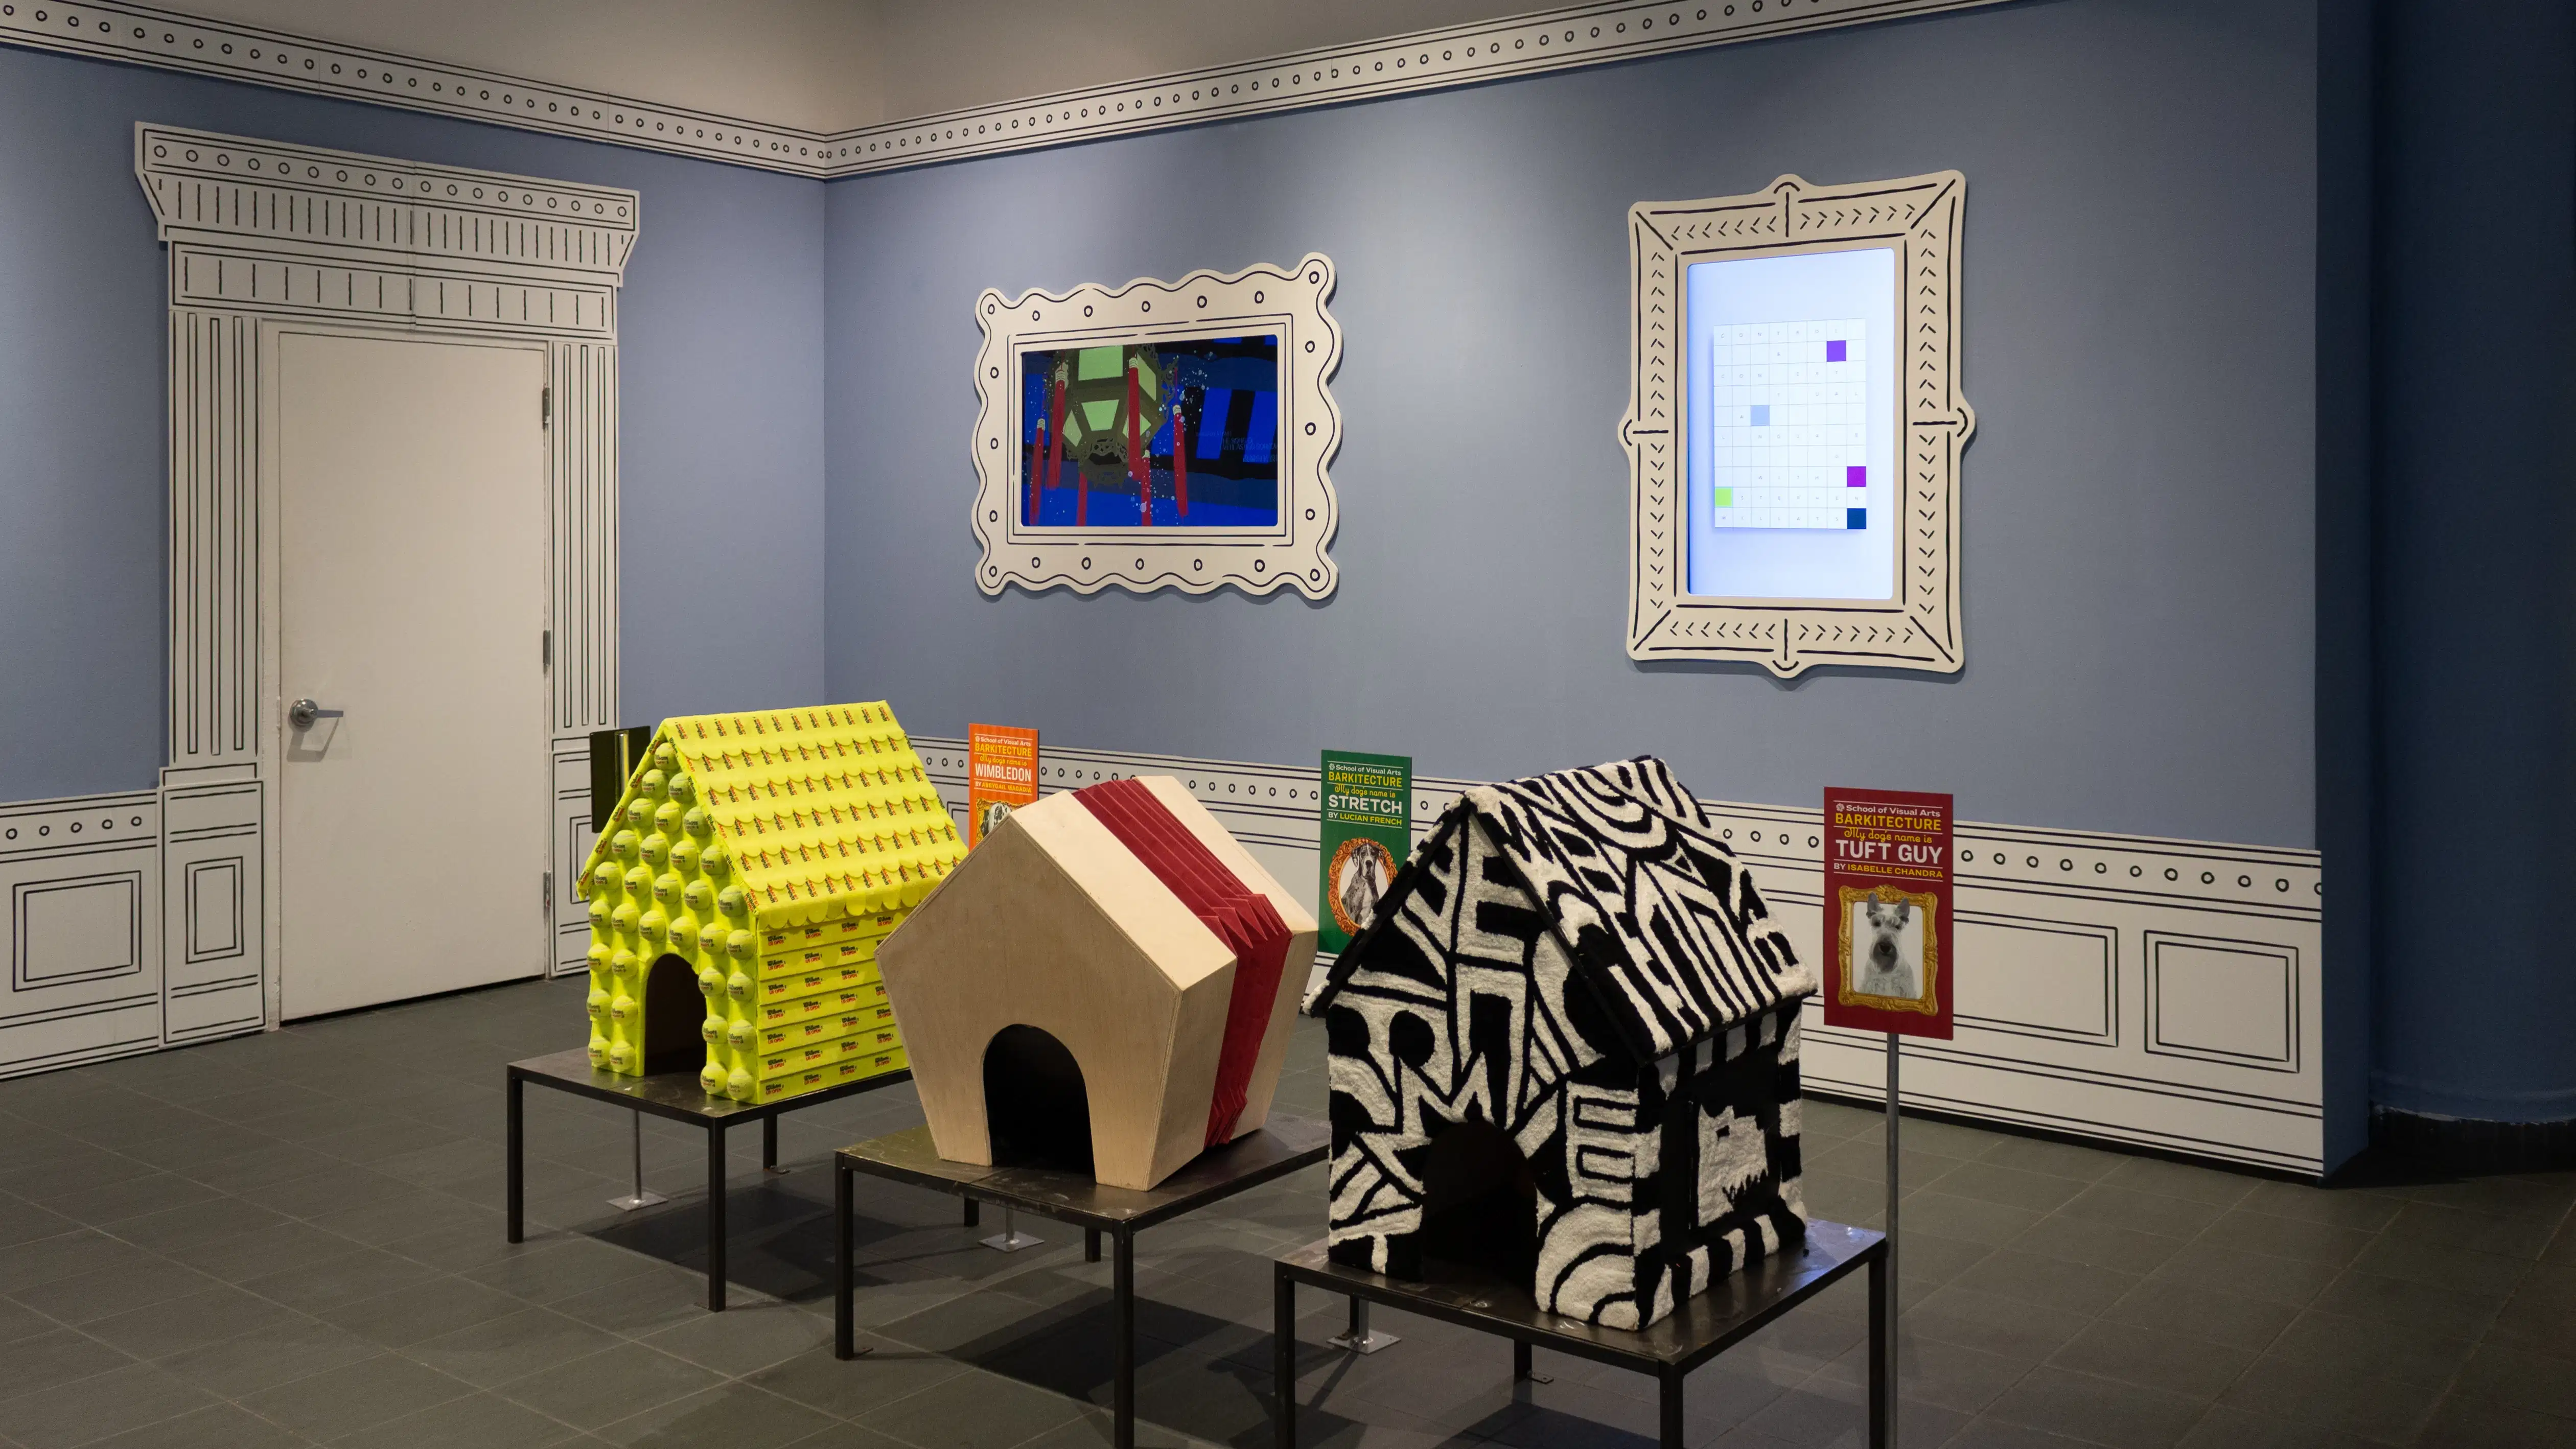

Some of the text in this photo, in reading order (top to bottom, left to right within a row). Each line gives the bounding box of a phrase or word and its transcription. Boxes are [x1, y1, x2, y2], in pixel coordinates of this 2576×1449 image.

[975, 743, 1032, 757] BARKITECTURE
[975, 763, 1031, 782] WIMBLEDON
[1329, 772, 1402, 787] BARKITECTURE
[1335, 783, 1349, 796] My
[1329, 794, 1402, 814] STRETCH
[1890, 807, 1917, 815] Visual
[1340, 813, 1368, 822] LUCIAN
[1370, 816, 1402, 825] FRENCH
[1836, 813, 1941, 831] BARKITECTURE
[1844, 827, 1865, 842] My
[1894, 834, 1920, 843] name
[1924, 835, 1932, 843] is
[1836, 839, 1942, 864] TUFT GUY
[1848, 864, 1892, 874] ISABELLE
[1895, 868, 1942, 878] CHANDRA
